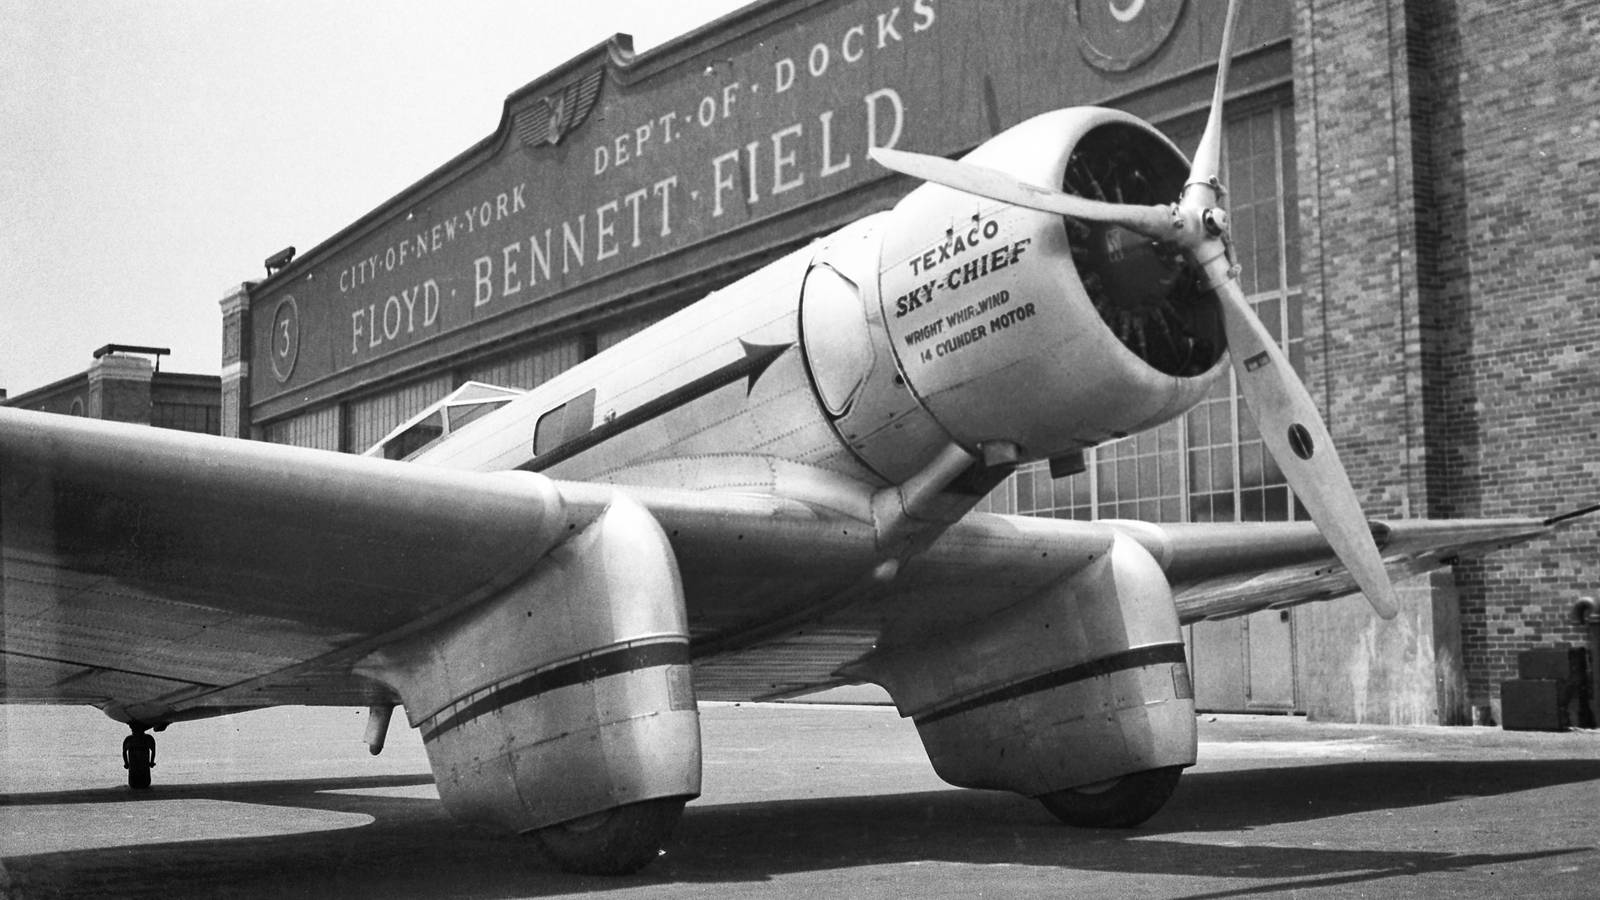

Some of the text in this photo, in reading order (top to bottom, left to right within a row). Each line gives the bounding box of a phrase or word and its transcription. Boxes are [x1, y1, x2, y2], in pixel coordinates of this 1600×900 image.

[698, 82, 740, 127] OF
[774, 0, 935, 94] DOCKS
[339, 183, 526, 293] CITY OF NEW YORK
[351, 88, 904, 355] FLOYD BENNETT FIELD
[909, 220, 998, 277] TEXACO
[895, 237, 1032, 319] SKY-CHIEF
[279, 318, 290, 358] 3
[904, 318, 944, 346] WRIGHT
[920, 302, 1036, 364] 14 CYLINDER MOTOR
